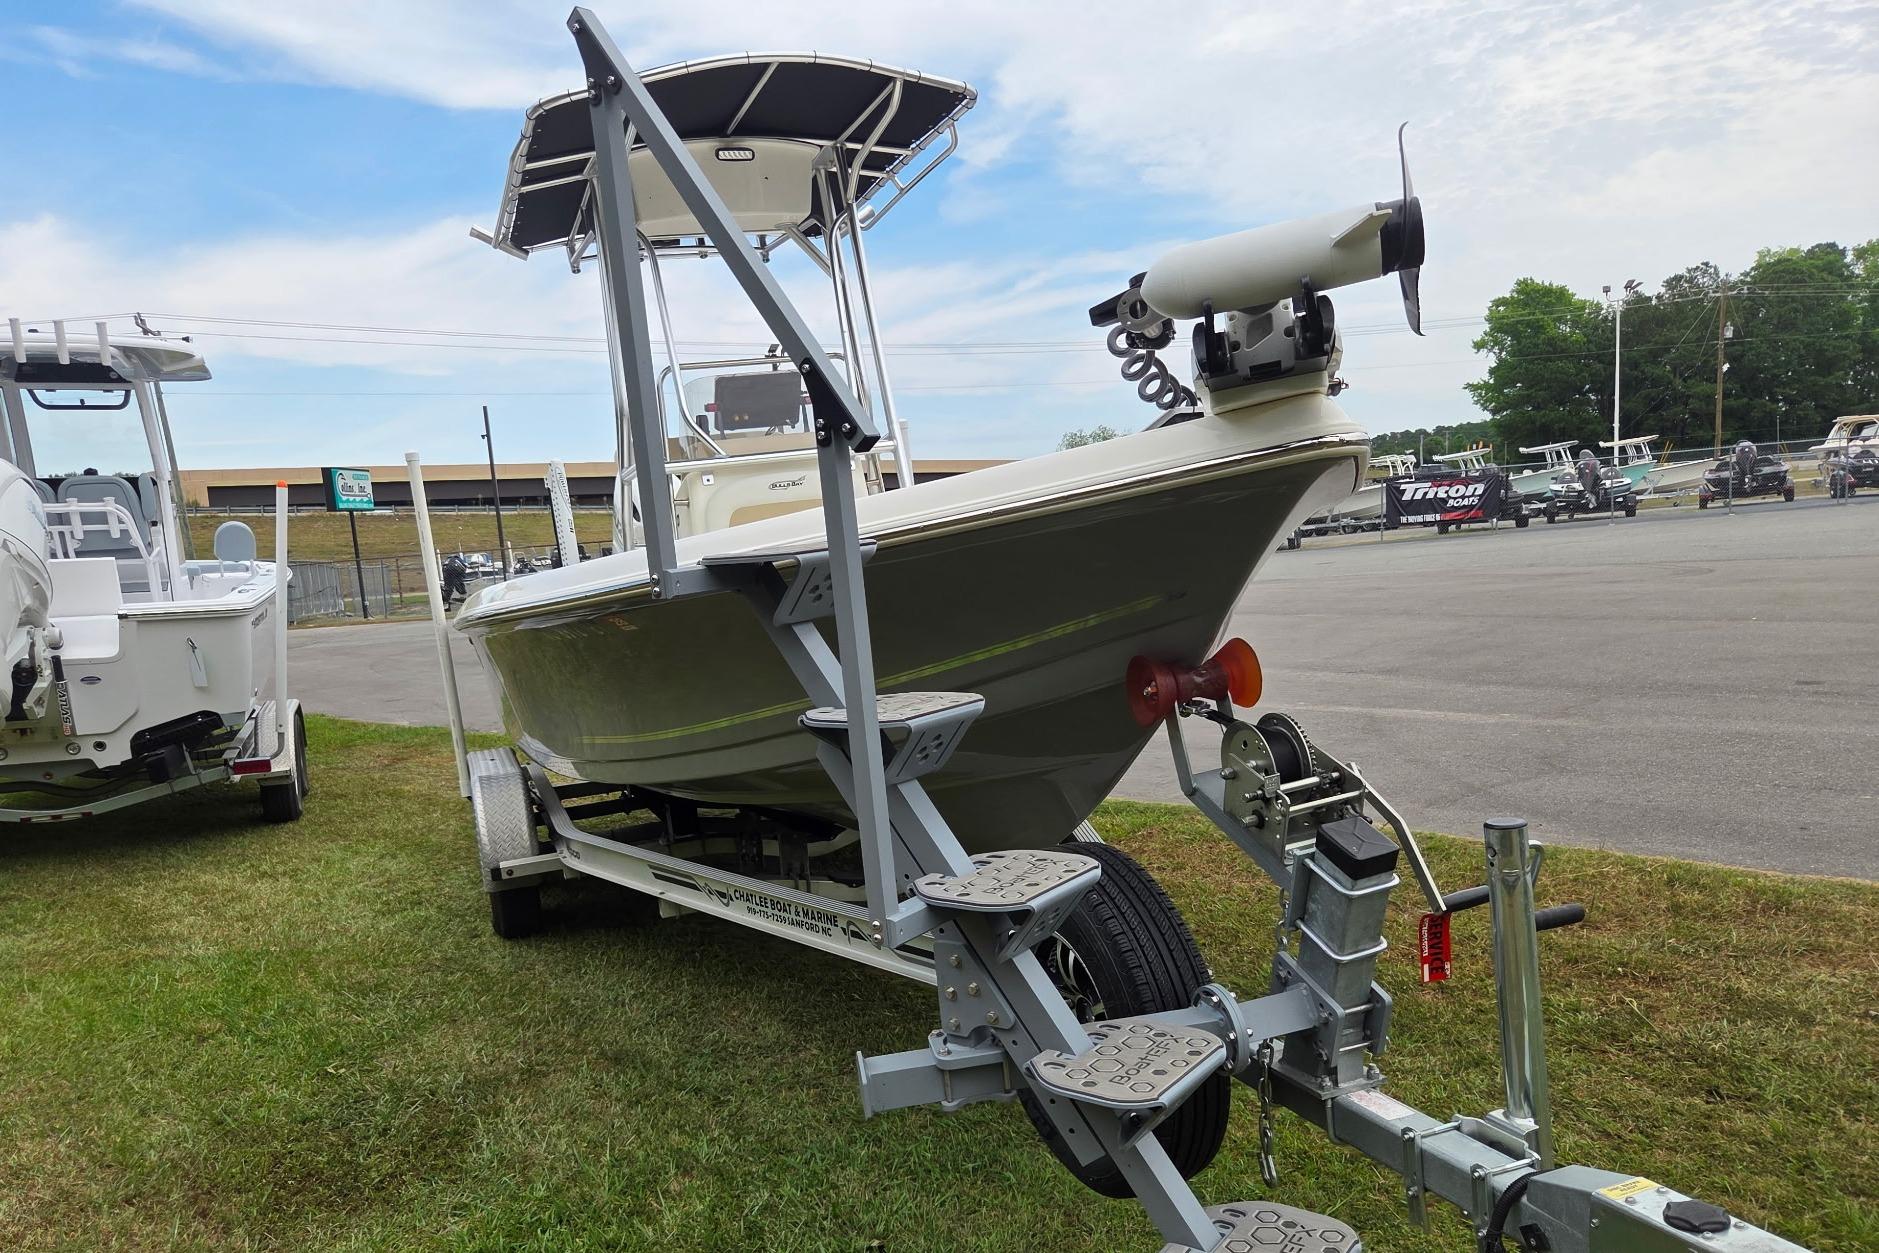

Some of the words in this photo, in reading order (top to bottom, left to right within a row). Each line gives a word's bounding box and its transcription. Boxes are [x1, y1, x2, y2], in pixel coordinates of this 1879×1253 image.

[1400, 482, 1485, 500] Triton
[1446, 496, 1480, 507] BOATS
[57, 688, 72, 726] ATLAS
[982, 859, 1065, 894] BoatEFX
[733, 889, 769, 909] CHATLEE
[769, 898, 792, 916] BOAT
[794, 905, 801, 918] &
[801, 907, 839, 928] MARINE
[746, 905, 787, 925] 919-775-7259
[787, 916, 820, 934] SANFORD
[821, 925, 832, 937] NC
[1429, 914, 1443, 974] SERVICE
[1108, 1034, 1185, 1085] BoatEFX
